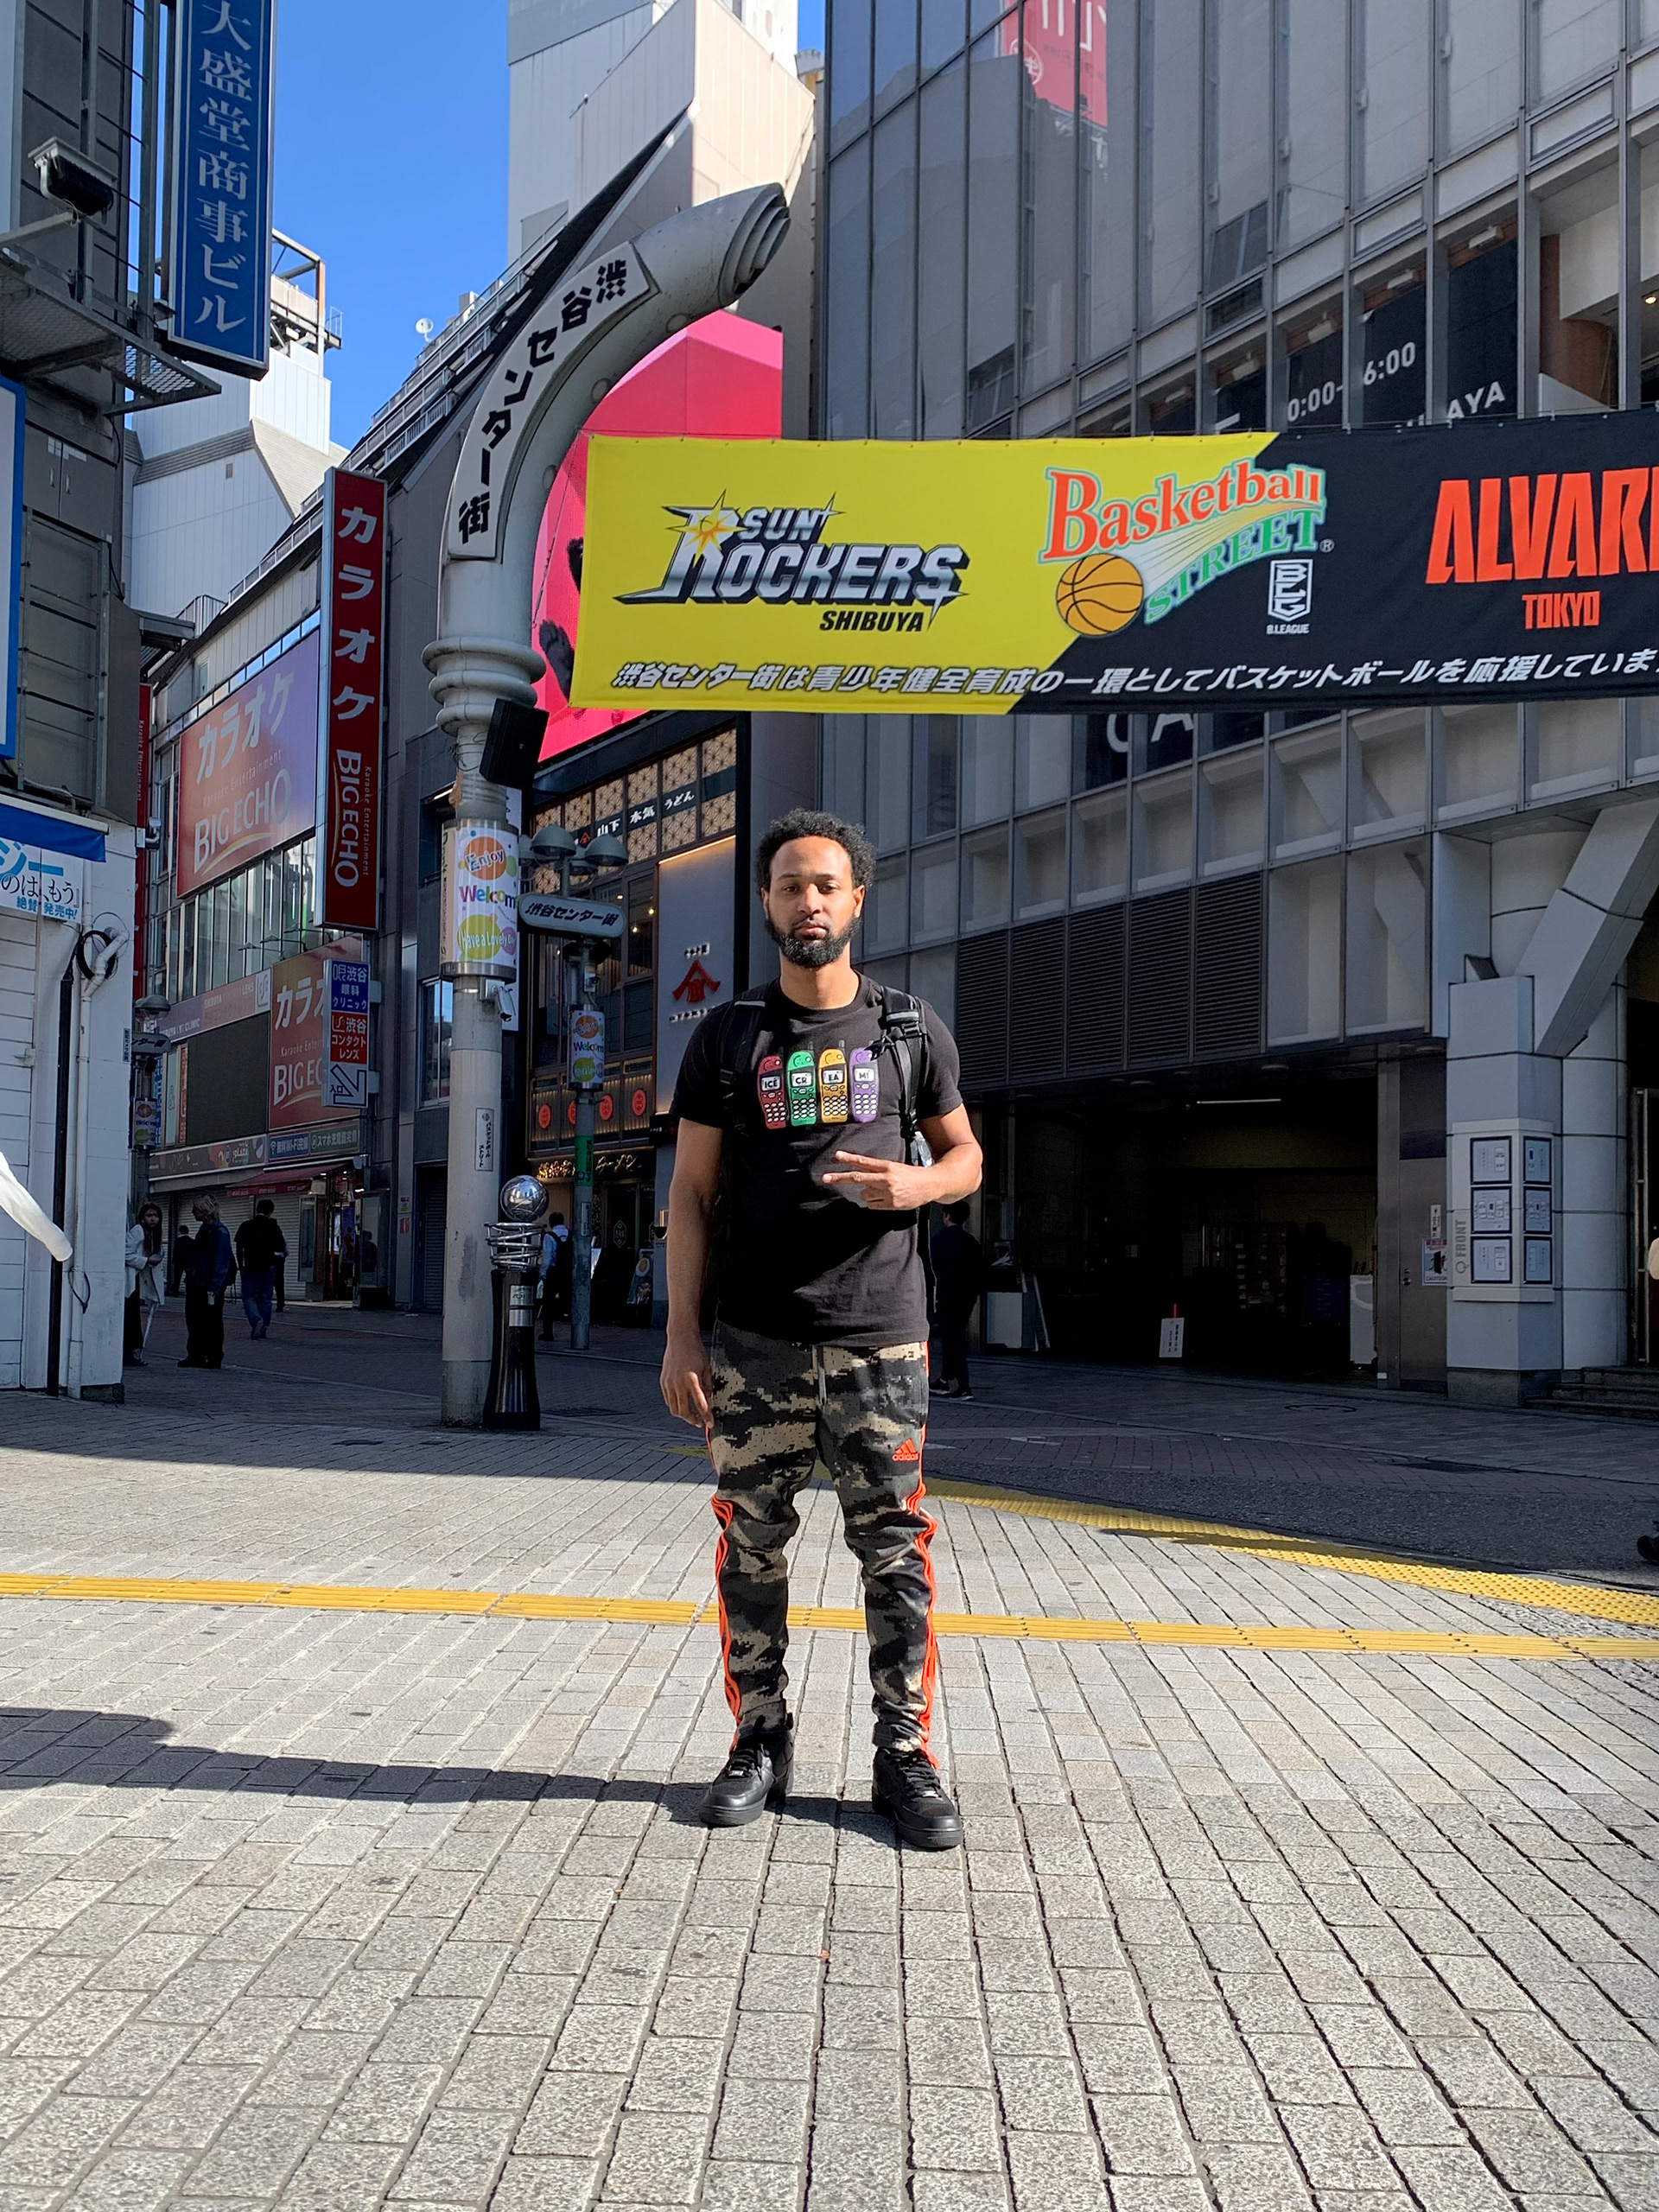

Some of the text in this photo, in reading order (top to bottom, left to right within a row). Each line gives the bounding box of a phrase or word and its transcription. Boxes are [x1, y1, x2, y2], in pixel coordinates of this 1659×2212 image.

[193, 0, 253, 334] 大盛堂商事ビル
[458, 258, 627, 545] 渋谷センター街
[736, 505, 831, 542] SUN
[1039, 456, 1325, 564] Basketball
[1426, 467, 1659, 584] ALVAR
[613, 501, 970, 607] ROCKERS
[1144, 508, 1325, 625] STREET
[332, 505, 378, 721] カラオケ
[818, 610, 926, 632] SHIBUYA
[1266, 624, 1310, 634] B.LEAGUE
[1522, 591, 1600, 629] TOKYO
[612, 648, 1659, 695] 渋谷センター街は青少年健全育成の一環としてバスケットボールを応援していま
[195, 671, 295, 785] カラオケ
[334, 748, 362, 887] BIG ECHO
[664, 790, 695, 810] うどん
[194, 768, 292, 874] BIG ECHO
[362, 766, 373, 877] Karaoke Entertainment
[464, 849, 505, 873] Enjoy
[524, 902, 620, 926] 渋谷センター街
[461, 929, 480, 950] Have
[480, 934, 486, 946] a
[486, 930, 507, 948] Lovely
[346, 968, 367, 983] 渋谷
[333, 996, 367, 1010] クリニック
[332, 1034, 366, 1047] コンタクト
[346, 1018, 367, 1034] 渋谷
[340, 1048, 359, 1060] レンズ
[273, 1063, 304, 1106] BIG
[1455, 1219, 1467, 1257] FRONT
[892, 1452, 919, 1462] adidas
